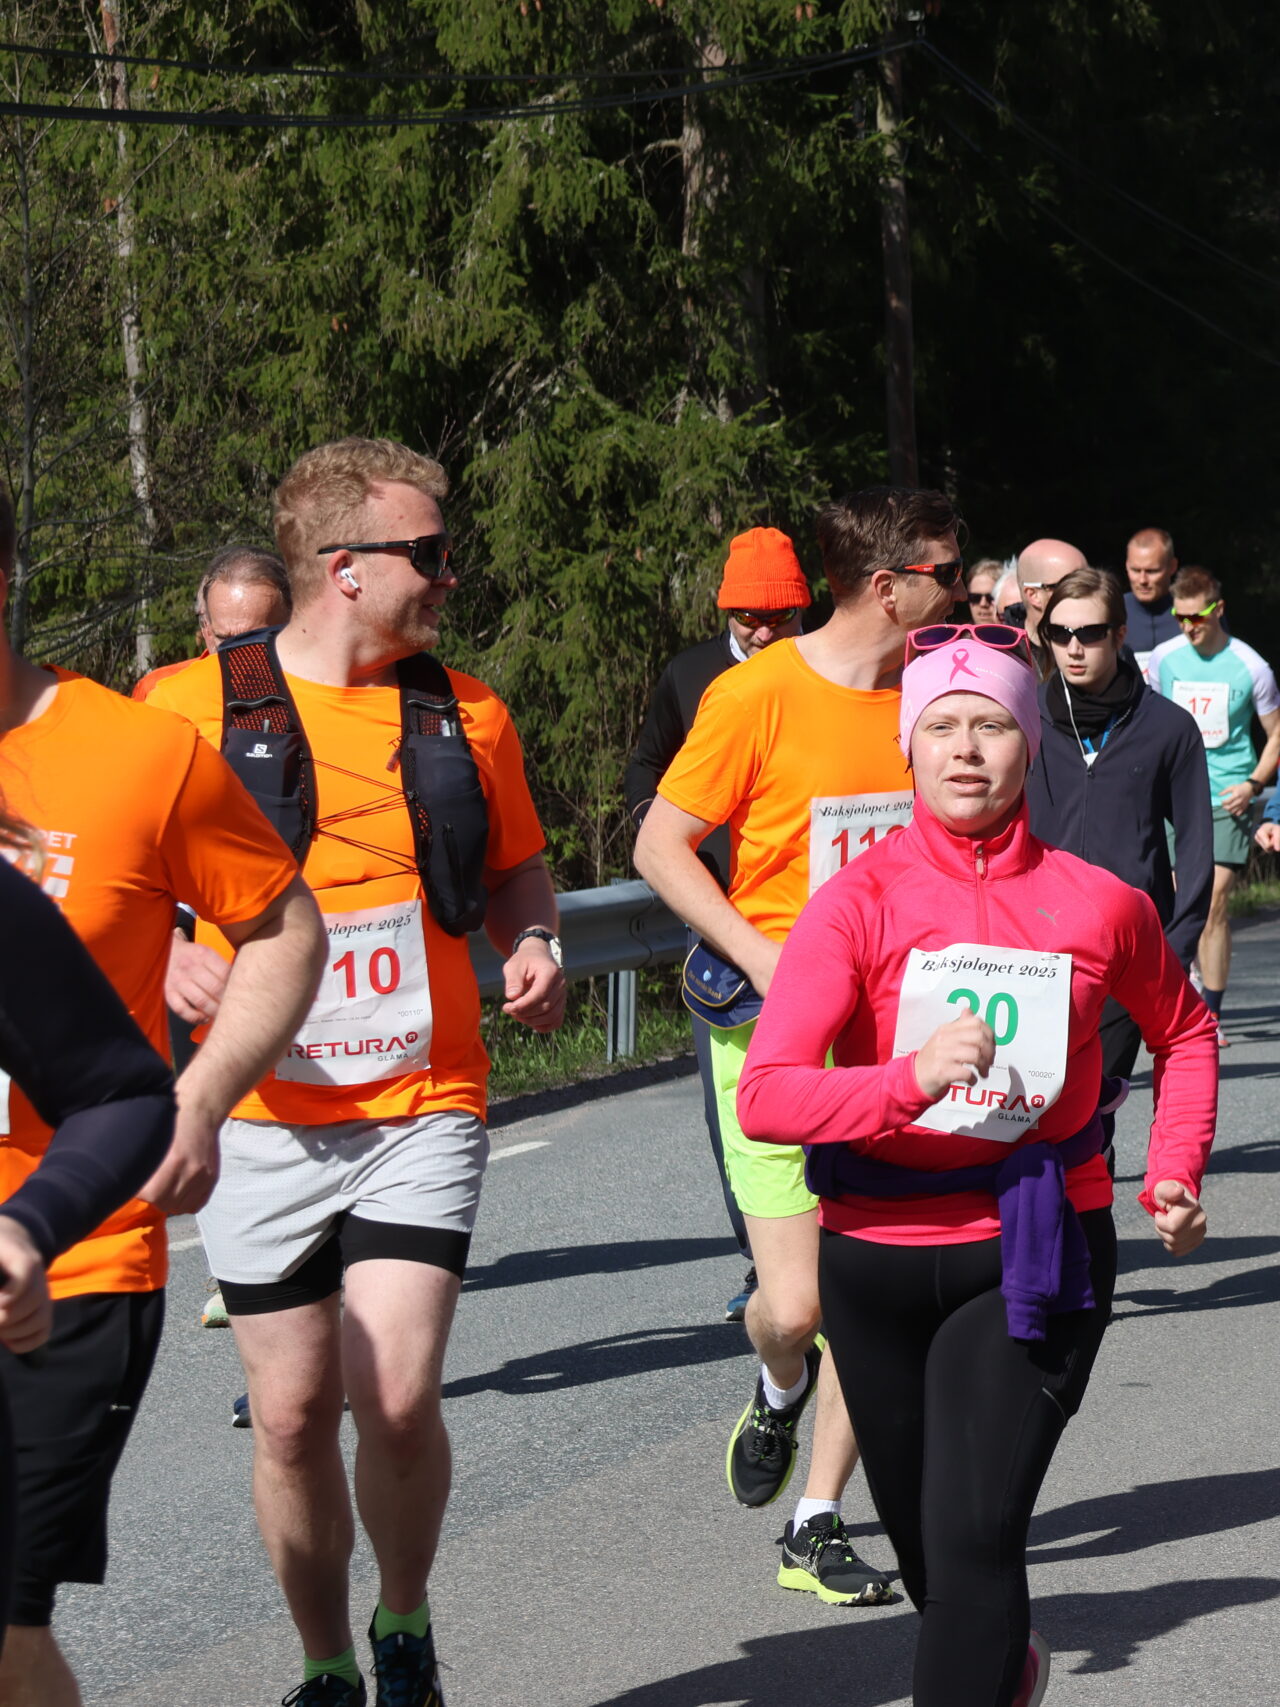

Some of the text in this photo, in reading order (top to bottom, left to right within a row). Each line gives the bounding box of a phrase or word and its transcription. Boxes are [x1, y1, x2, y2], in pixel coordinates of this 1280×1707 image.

[1188, 697, 1213, 715] 17
[893, 800, 914, 811] 202
[832, 824, 905, 868] 11
[325, 914, 411, 938] øløpet 2025
[332, 946, 401, 999] 10
[1019, 965, 1058, 979] 2025
[946, 988, 1019, 1046] 20
[288, 1036, 407, 1060] RETURA
[950, 1085, 1031, 1113] TURA
